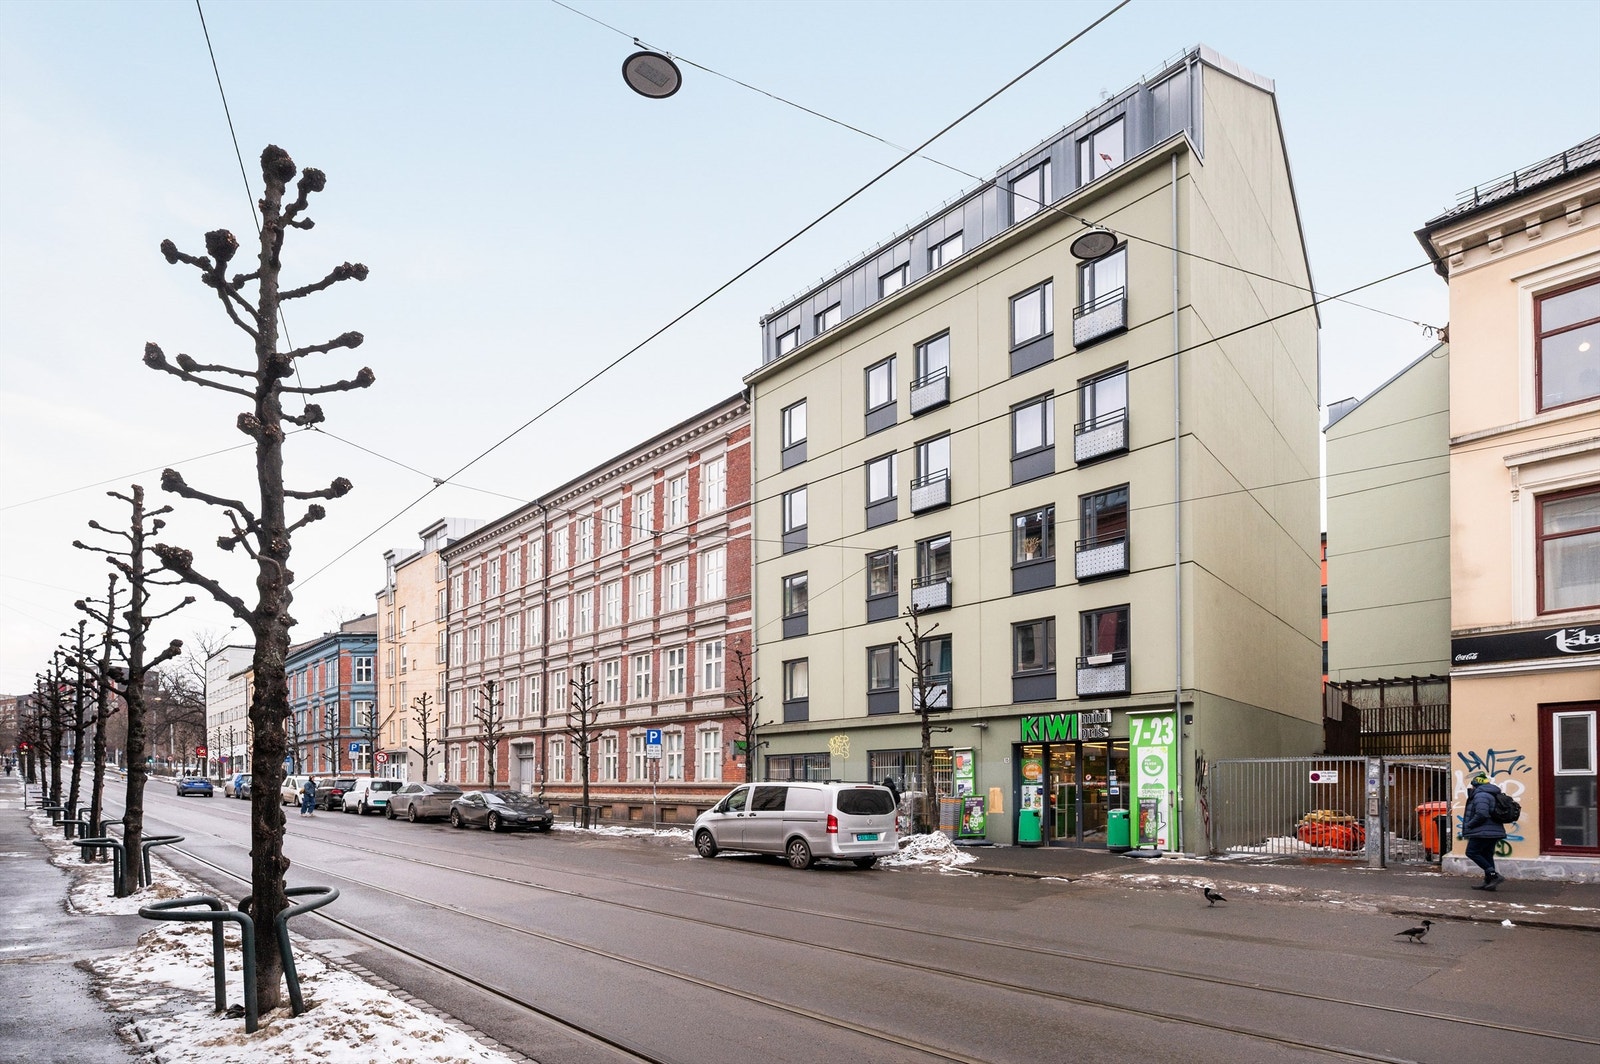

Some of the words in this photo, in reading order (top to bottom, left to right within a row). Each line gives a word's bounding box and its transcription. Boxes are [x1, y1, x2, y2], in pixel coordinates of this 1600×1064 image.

[1081, 709, 1111, 724] mini
[1021, 713, 1078, 742] KIWI
[1081, 725, 1109, 741] pris
[1132, 717, 1174, 746] 7-23
[650, 731, 658, 743] P
[351, 743, 358, 751] P
